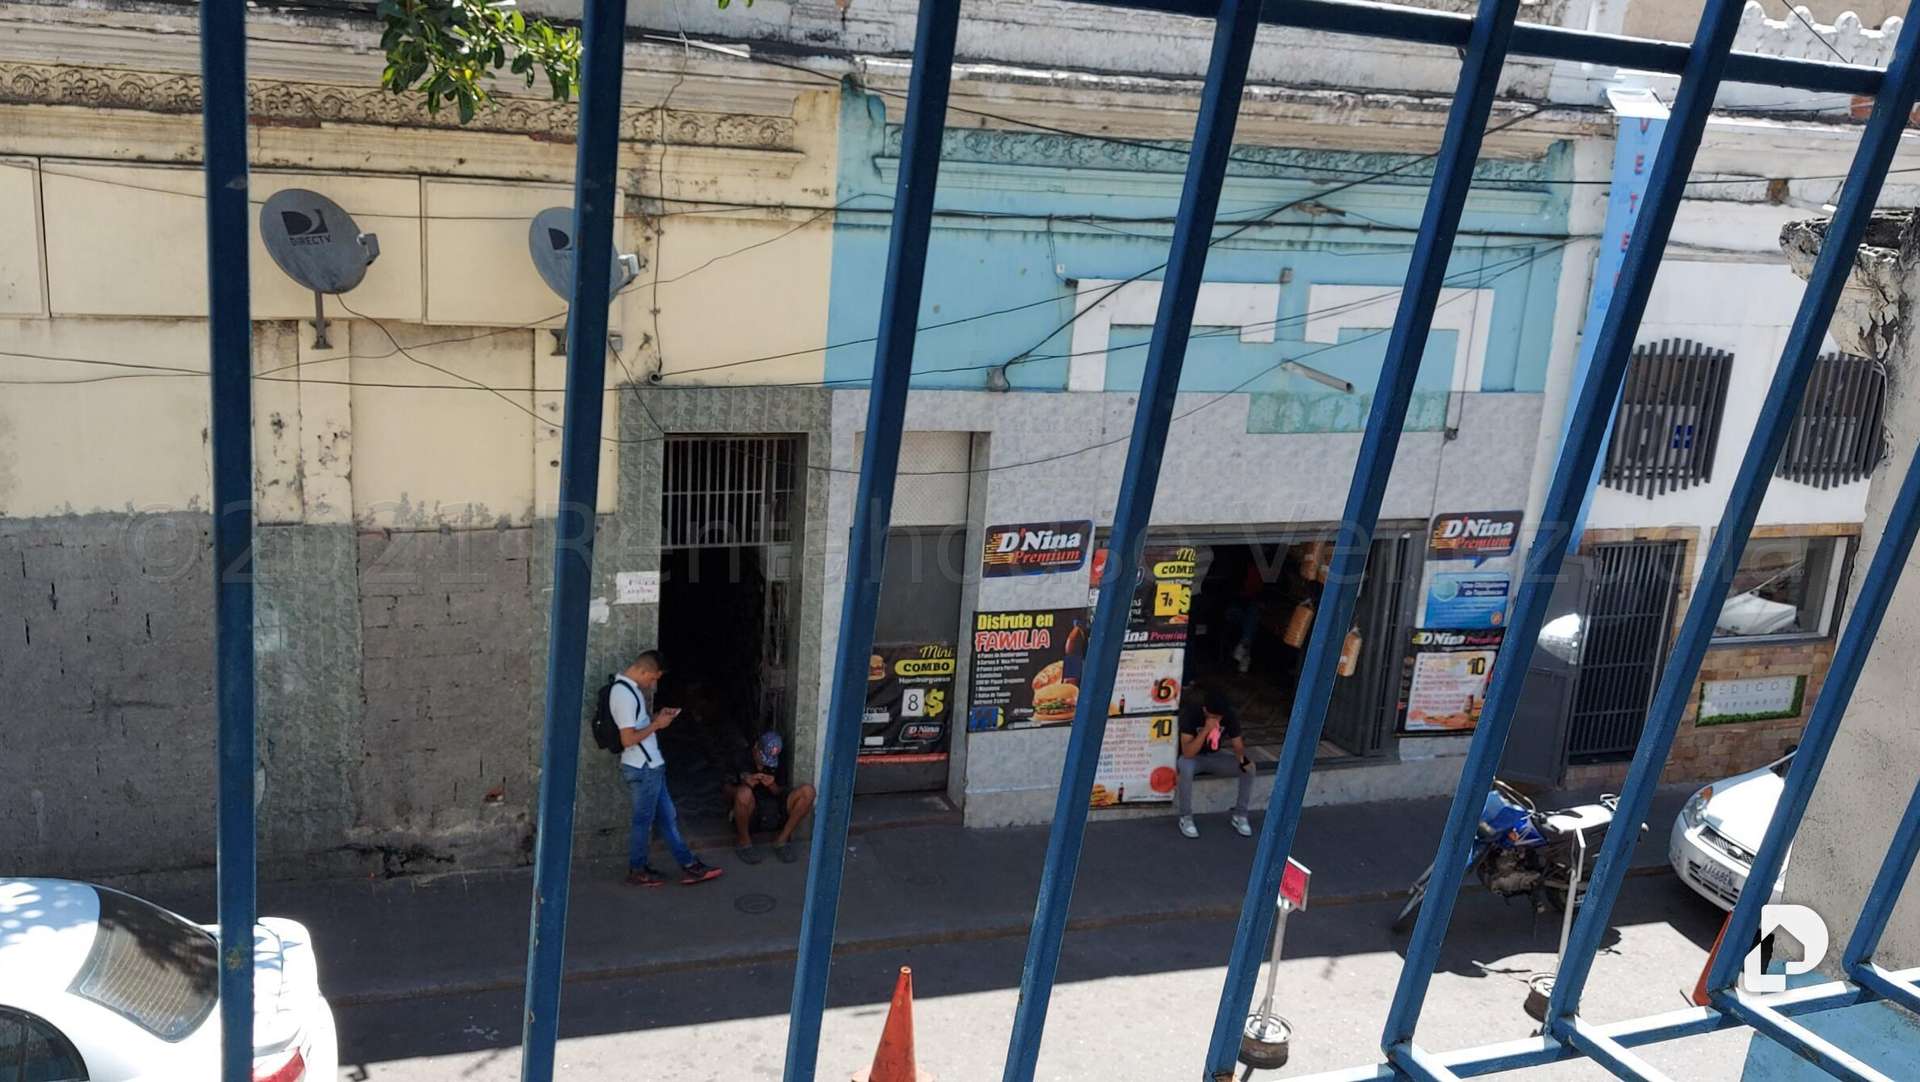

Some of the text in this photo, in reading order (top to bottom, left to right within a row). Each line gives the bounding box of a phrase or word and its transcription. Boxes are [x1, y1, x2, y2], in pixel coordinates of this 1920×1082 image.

[289, 234, 332, 247] DIRECTV
[1443, 516, 1514, 537] D'Nina
[997, 528, 1082, 552] D'Nina
[1455, 536, 1512, 549] Premium
[1014, 550, 1081, 565] Premium
[977, 613, 1055, 630] Disfruta en
[974, 629, 1051, 652] FAMILIA
[920, 645, 953, 659] Mini
[903, 662, 950, 673] COMBO
[1467, 657, 1486, 675] 10
[907, 687, 945, 717] 8 $
[1152, 718, 1173, 739] 10
